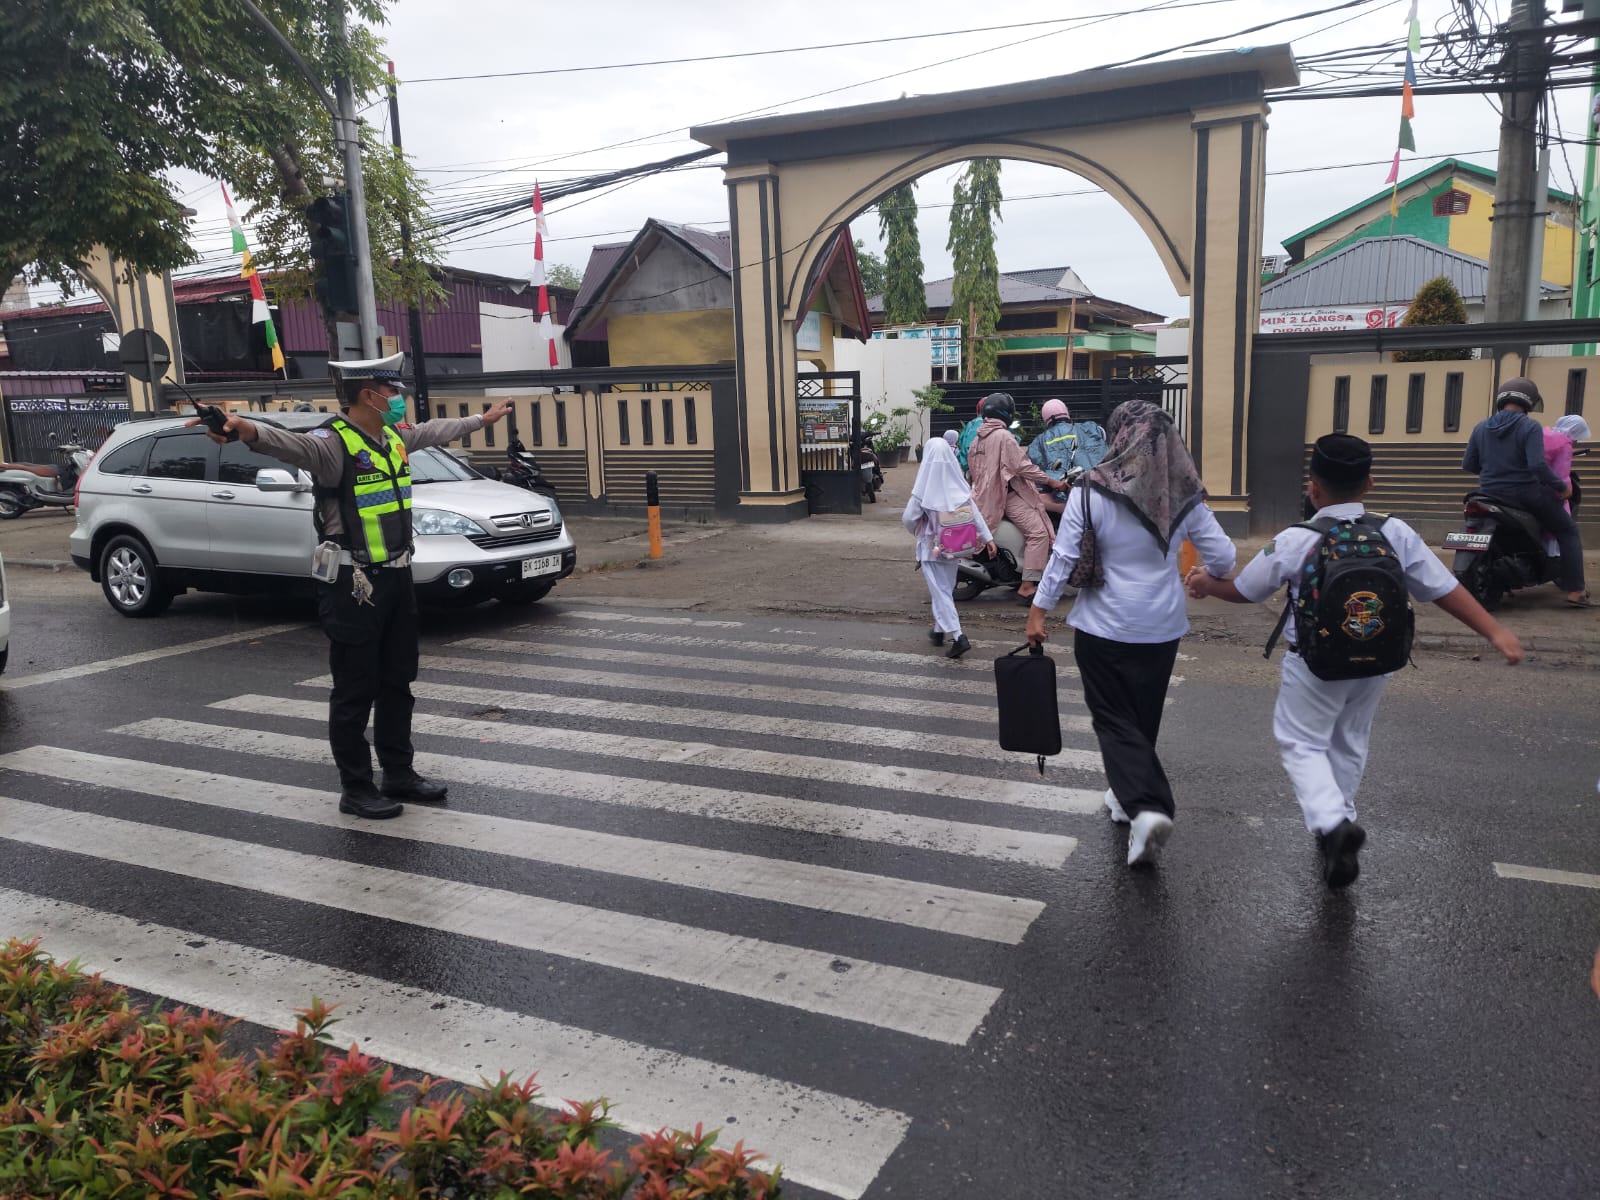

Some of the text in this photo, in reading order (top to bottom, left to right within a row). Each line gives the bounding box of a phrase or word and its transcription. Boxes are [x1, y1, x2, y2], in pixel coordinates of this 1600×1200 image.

[1261, 317, 1286, 326] MIN
[1289, 316, 1297, 324] 2
[1301, 314, 1354, 323] LANGSA
